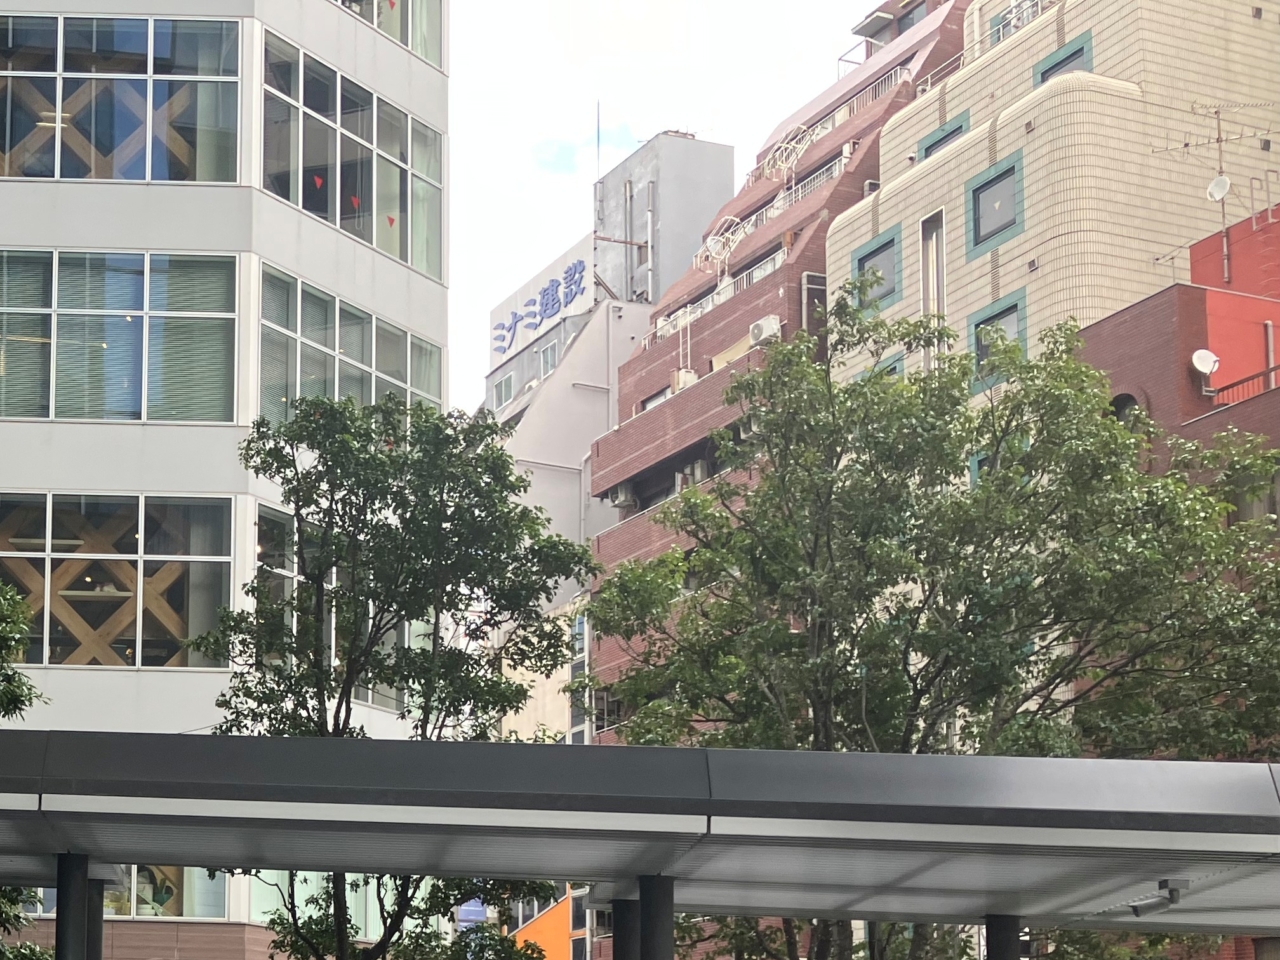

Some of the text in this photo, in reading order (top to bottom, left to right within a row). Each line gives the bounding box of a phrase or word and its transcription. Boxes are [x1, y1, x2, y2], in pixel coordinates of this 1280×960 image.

[492, 258, 586, 355] ミナミ建設
